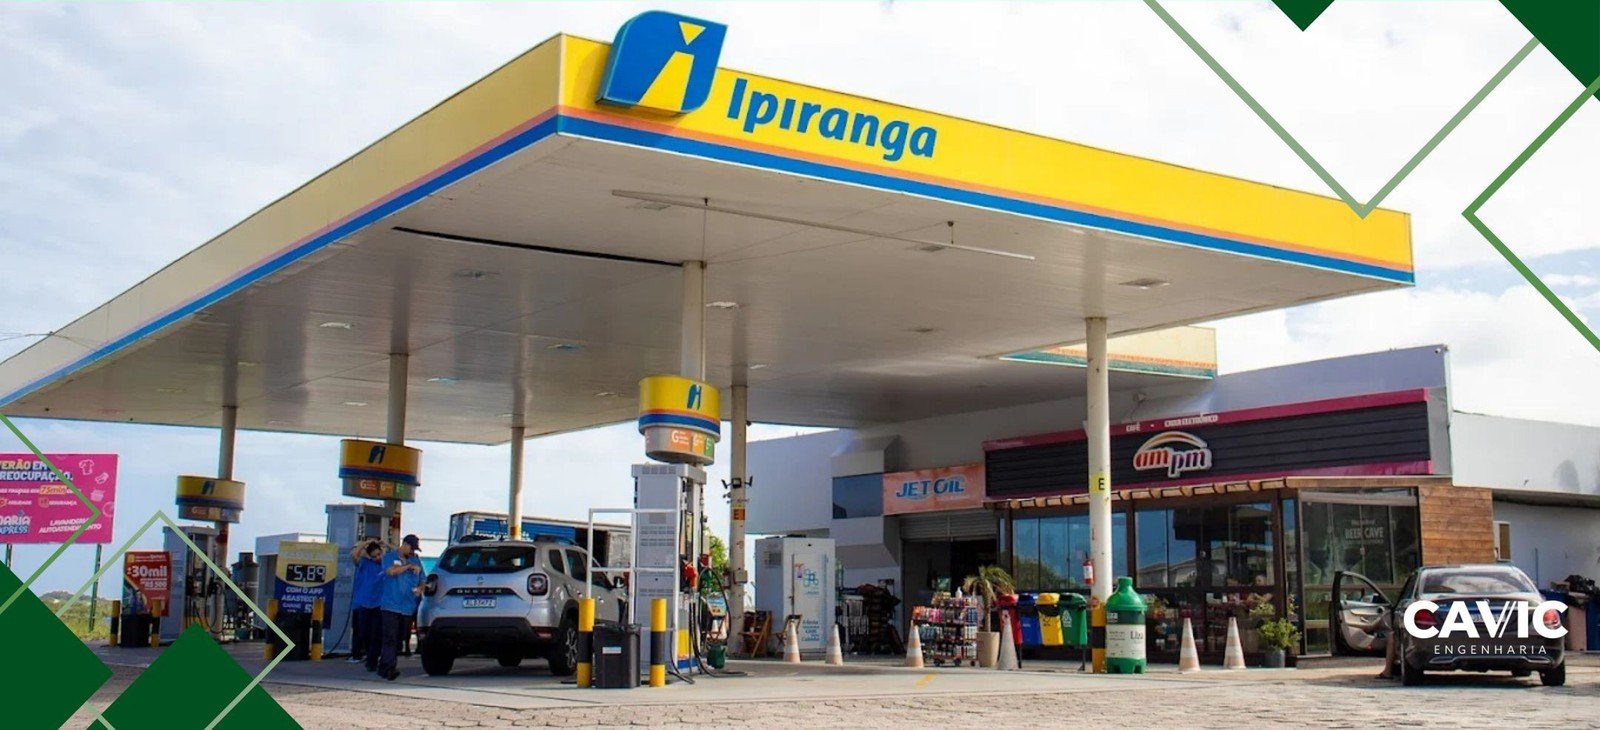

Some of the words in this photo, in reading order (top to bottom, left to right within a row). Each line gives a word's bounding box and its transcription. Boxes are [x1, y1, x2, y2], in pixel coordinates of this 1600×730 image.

[727, 77, 937, 162] Ipiranga
[1134, 448, 1211, 478] ampm
[896, 482, 931, 497] JET
[934, 479, 964, 494] OIL
[1345, 528, 1362, 539] BEER
[1364, 527, 1384, 538] CAVE
